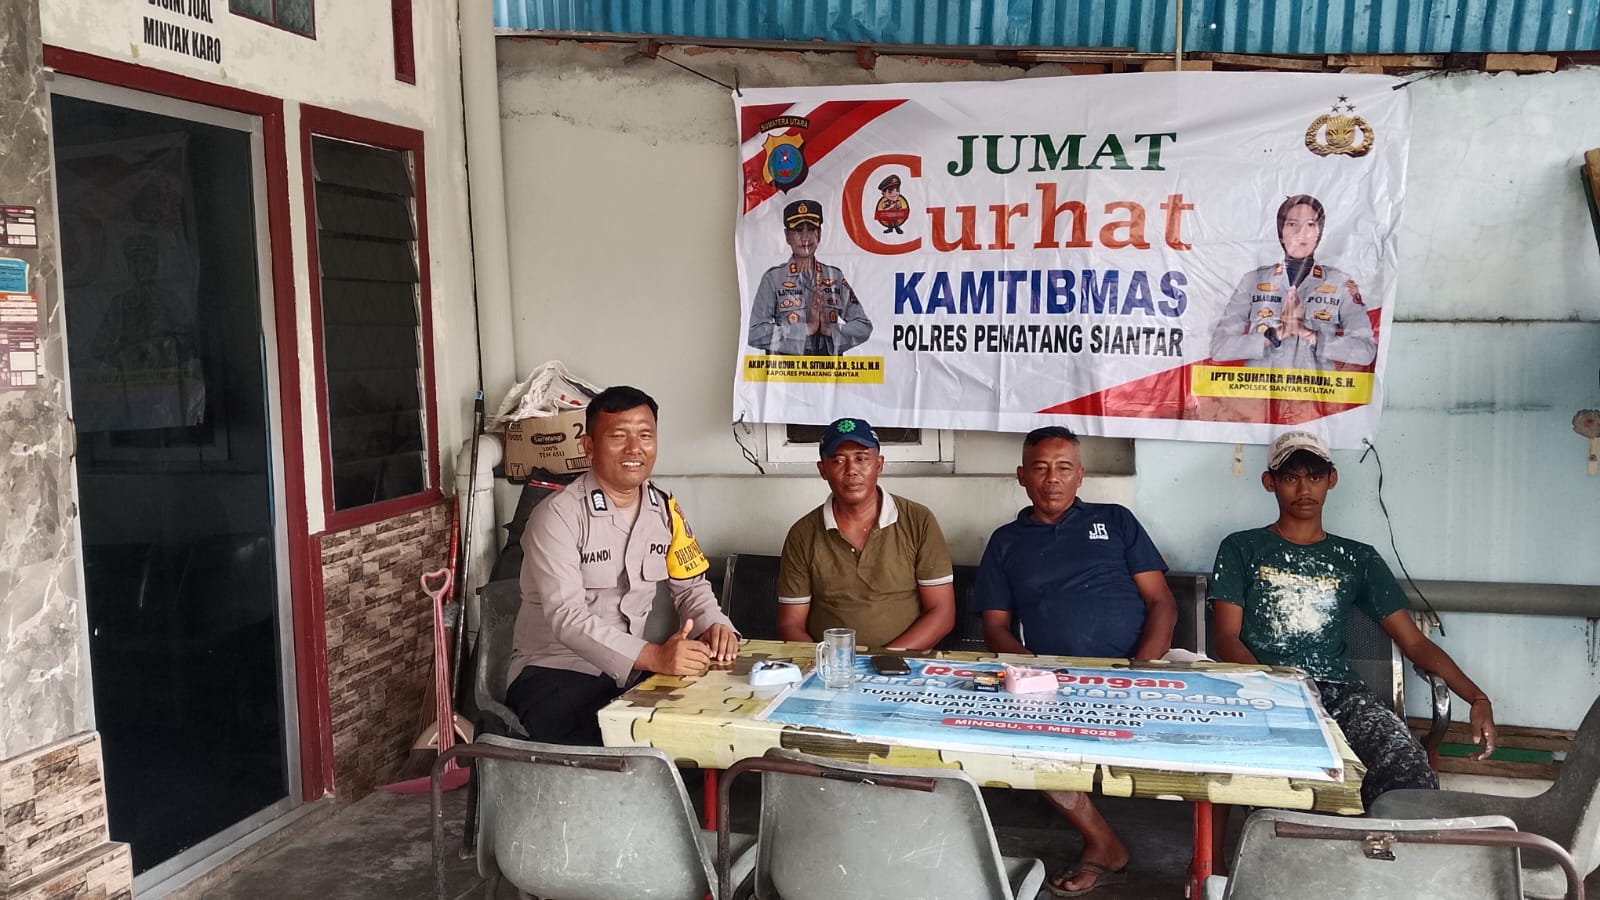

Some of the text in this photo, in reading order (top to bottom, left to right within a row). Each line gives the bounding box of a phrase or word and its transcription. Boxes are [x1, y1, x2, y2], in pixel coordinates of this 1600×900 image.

[143, 16, 221, 65] MINYAK KARO
[760, 117, 809, 132] SUMATERA UTARA
[946, 132, 1177, 177] JUMAT
[841, 153, 1195, 256] Curhat
[894, 269, 1188, 318] KAMTIBMAS
[1307, 296, 1340, 306] POLRI
[893, 324, 1184, 357] POLRES PEMATANG SIANTAR
[748, 360, 765, 369] AKBP
[1210, 371, 1235, 382] IPTU
[1237, 372, 1284, 384] SUHAIRA
[1269, 385, 1302, 393] SIANTAR
[861, 687, 911, 697] TUGU
[1092, 703, 1145, 713] DESA
[1149, 706, 1244, 718] SILALAHI
[880, 695, 1212, 724] PUNGUAN SONDI RAJA SEKTOR IV
[1140, 690, 1275, 710] Padang
[942, 707, 1144, 727] PEMATANGSIANTAR
[954, 718, 1022, 730] MINGGU,
[1048, 726, 1076, 734] MEI
[1079, 728, 1118, 737] 2025
